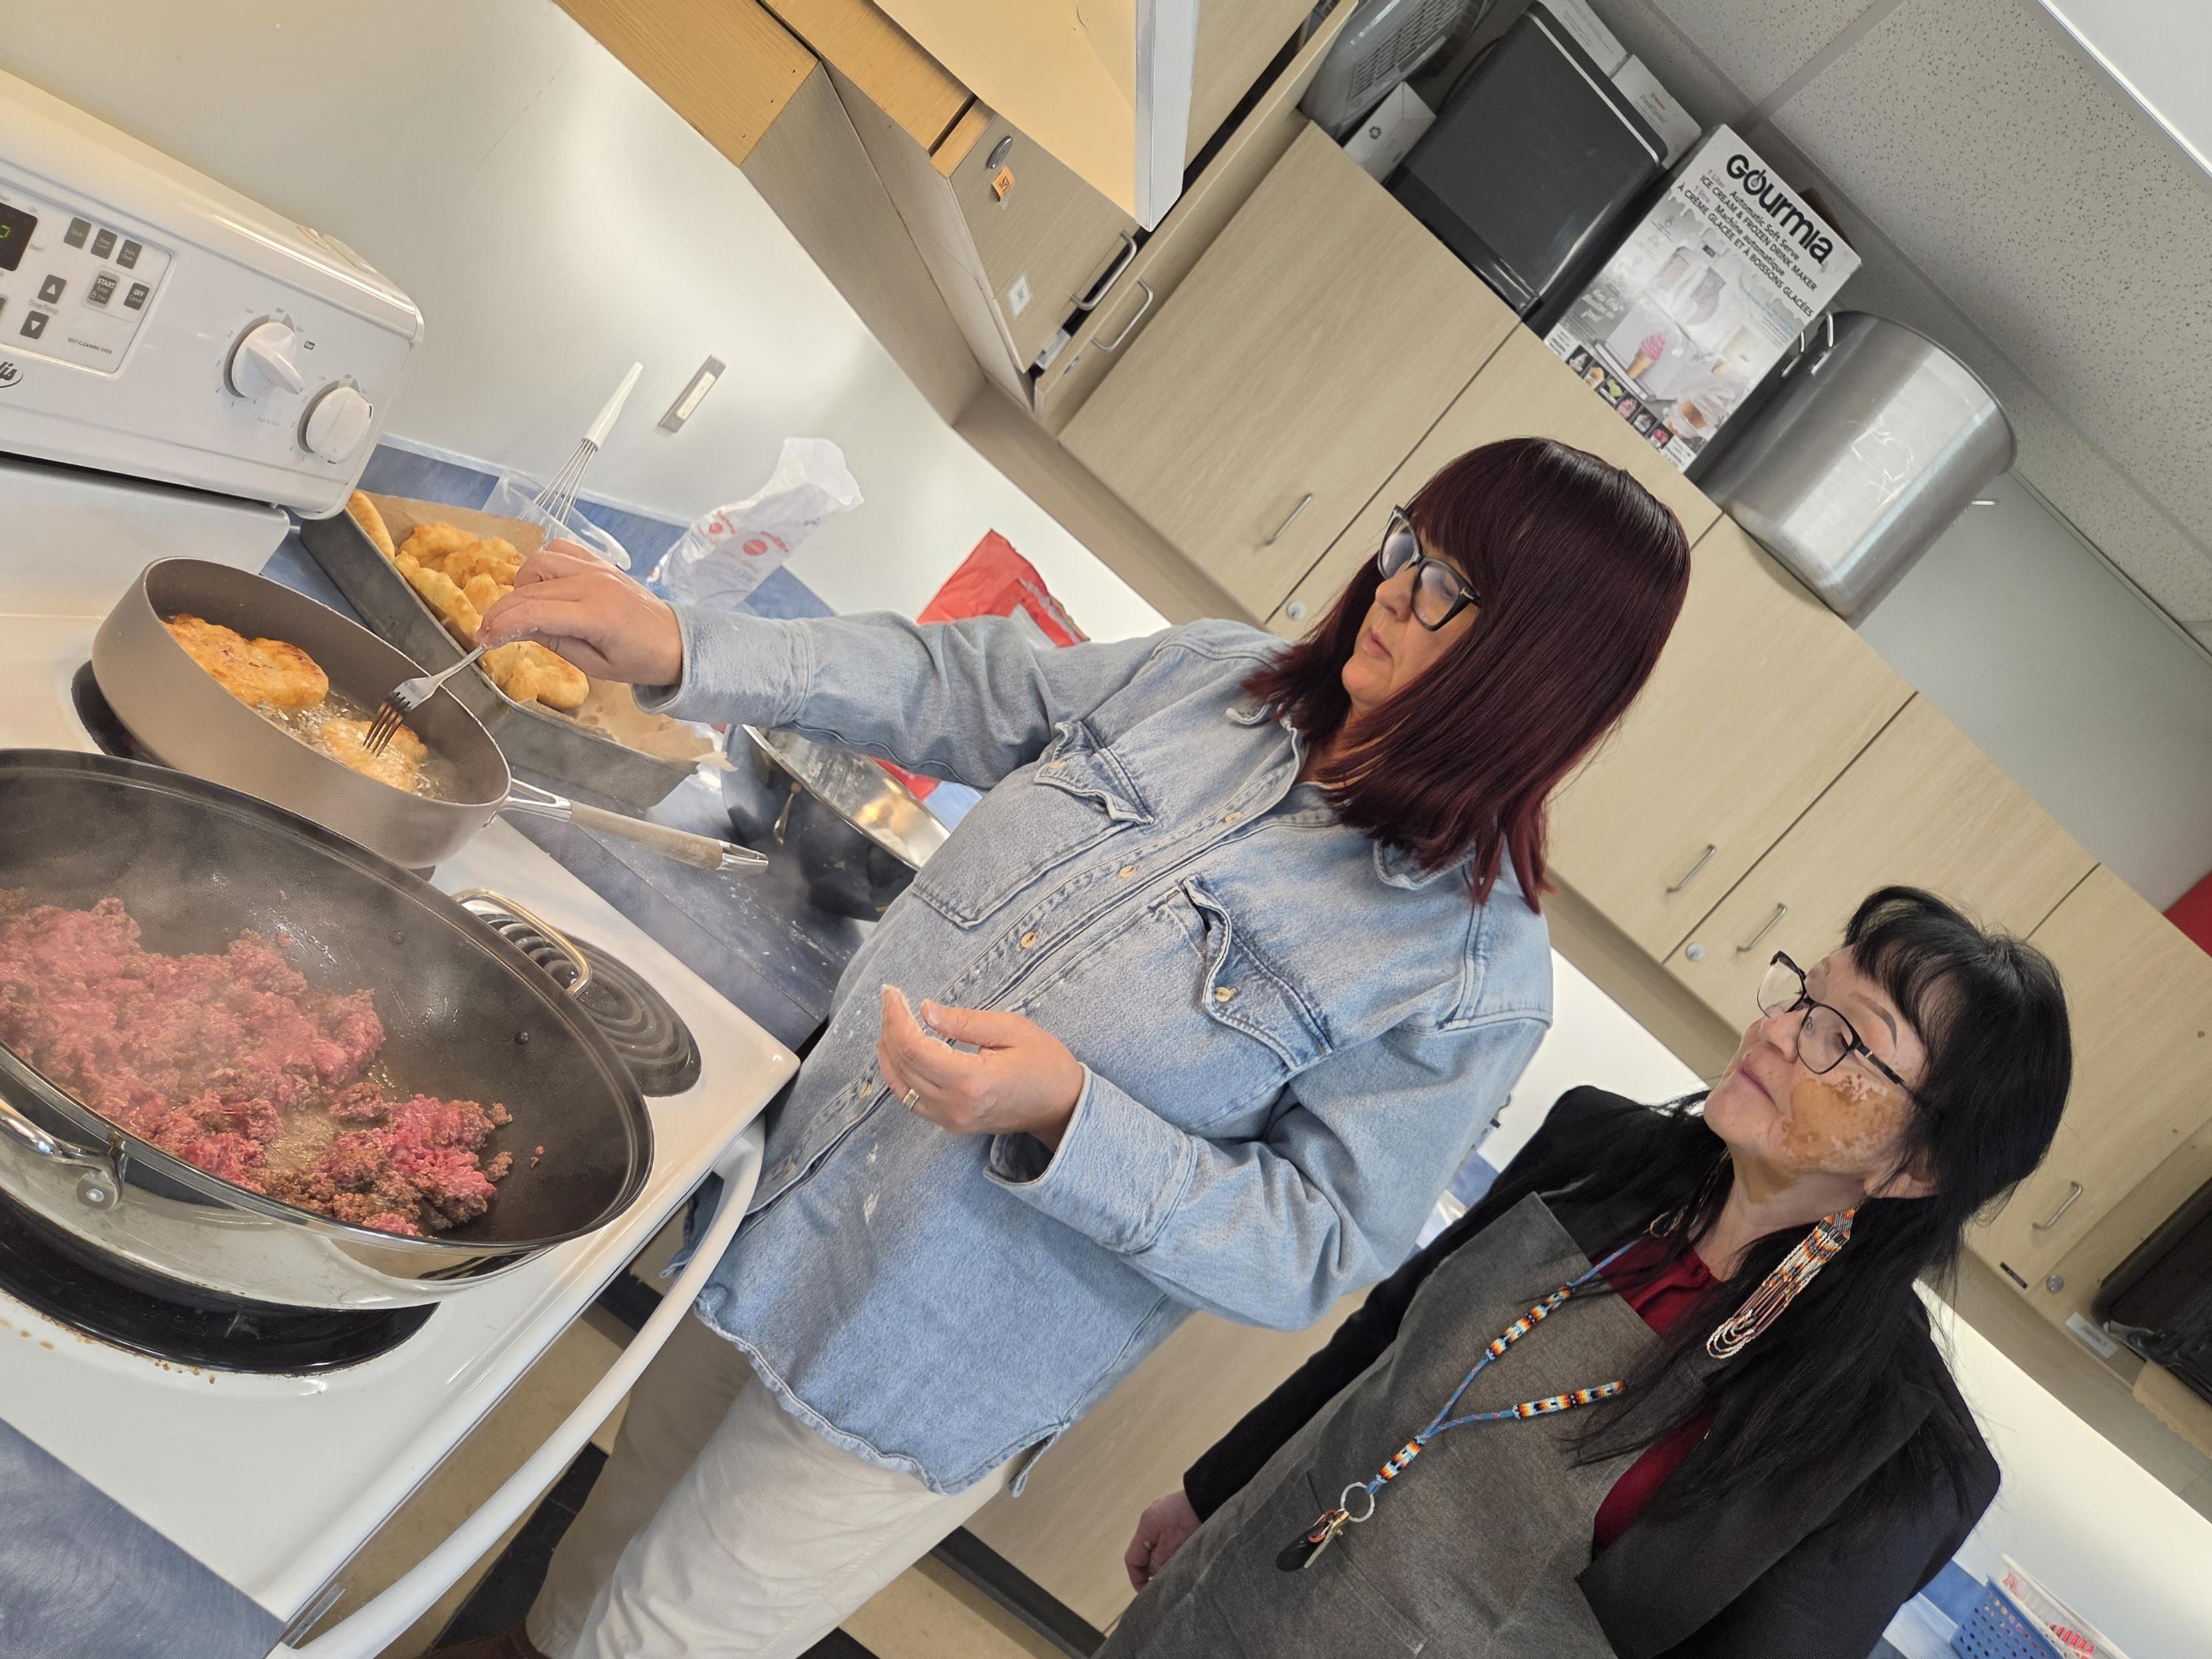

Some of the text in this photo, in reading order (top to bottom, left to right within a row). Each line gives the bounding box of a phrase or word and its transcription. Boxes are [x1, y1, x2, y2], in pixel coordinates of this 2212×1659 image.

[1700, 174, 1817, 291] ICE CREAM & FROZEN DRINK MAKER
[1714, 204, 1744, 235] Machine
[1742, 234, 1785, 277] automatique
[1726, 154, 1834, 265] Gourmia
[1730, 190, 1800, 261] Automatic Soft Serve
[96, 277, 116, 289] START
[133, 289, 144, 297] OFF
[1734, 237, 1746, 249] ET
[1749, 253, 1784, 289] BOISSONS
[1782, 285, 1814, 317] GLACÉES
